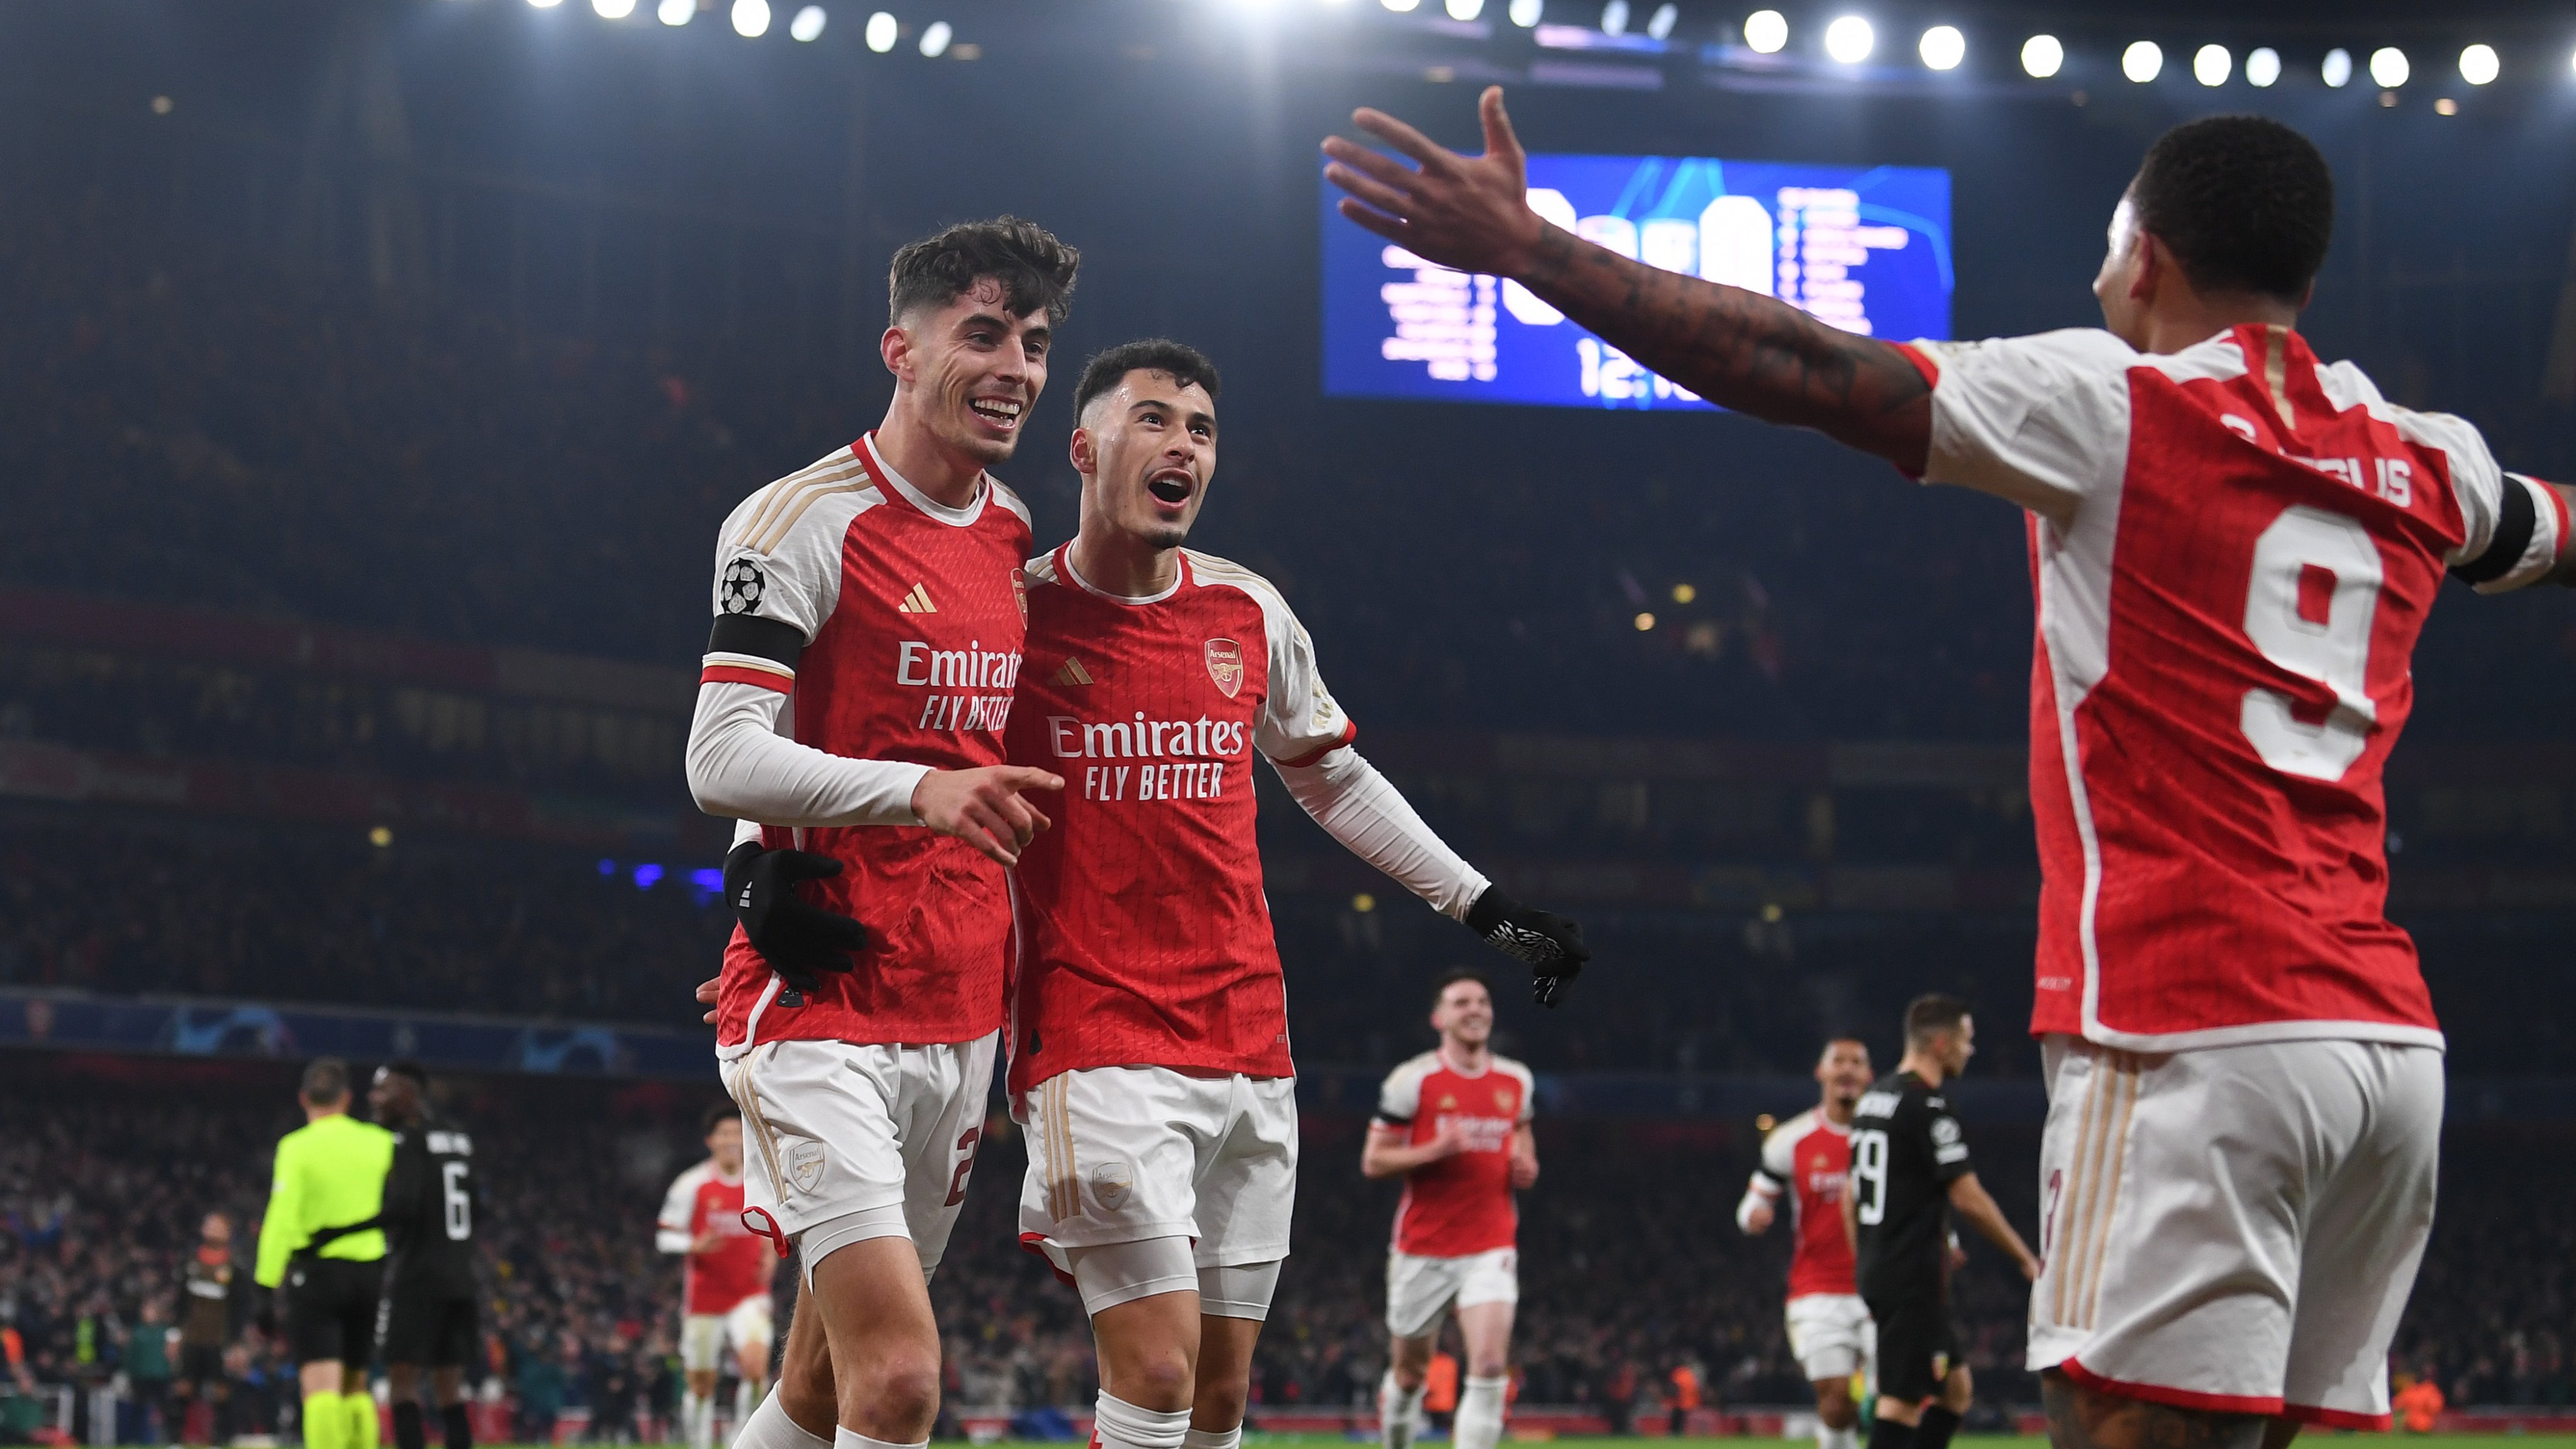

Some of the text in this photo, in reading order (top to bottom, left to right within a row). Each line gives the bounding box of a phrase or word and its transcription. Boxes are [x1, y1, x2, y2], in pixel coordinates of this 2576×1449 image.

[897, 640, 1023, 689] Emirate
[1209, 649, 1236, 659] Arsenal
[2239, 504, 2383, 782] 9
[918, 695, 965, 731] FLY
[1046, 711, 1244, 758] Emirates
[1085, 762, 1223, 801] FLY BETTER
[795, 1147, 819, 1161] Arsenal
[443, 1161, 472, 1241] 6
